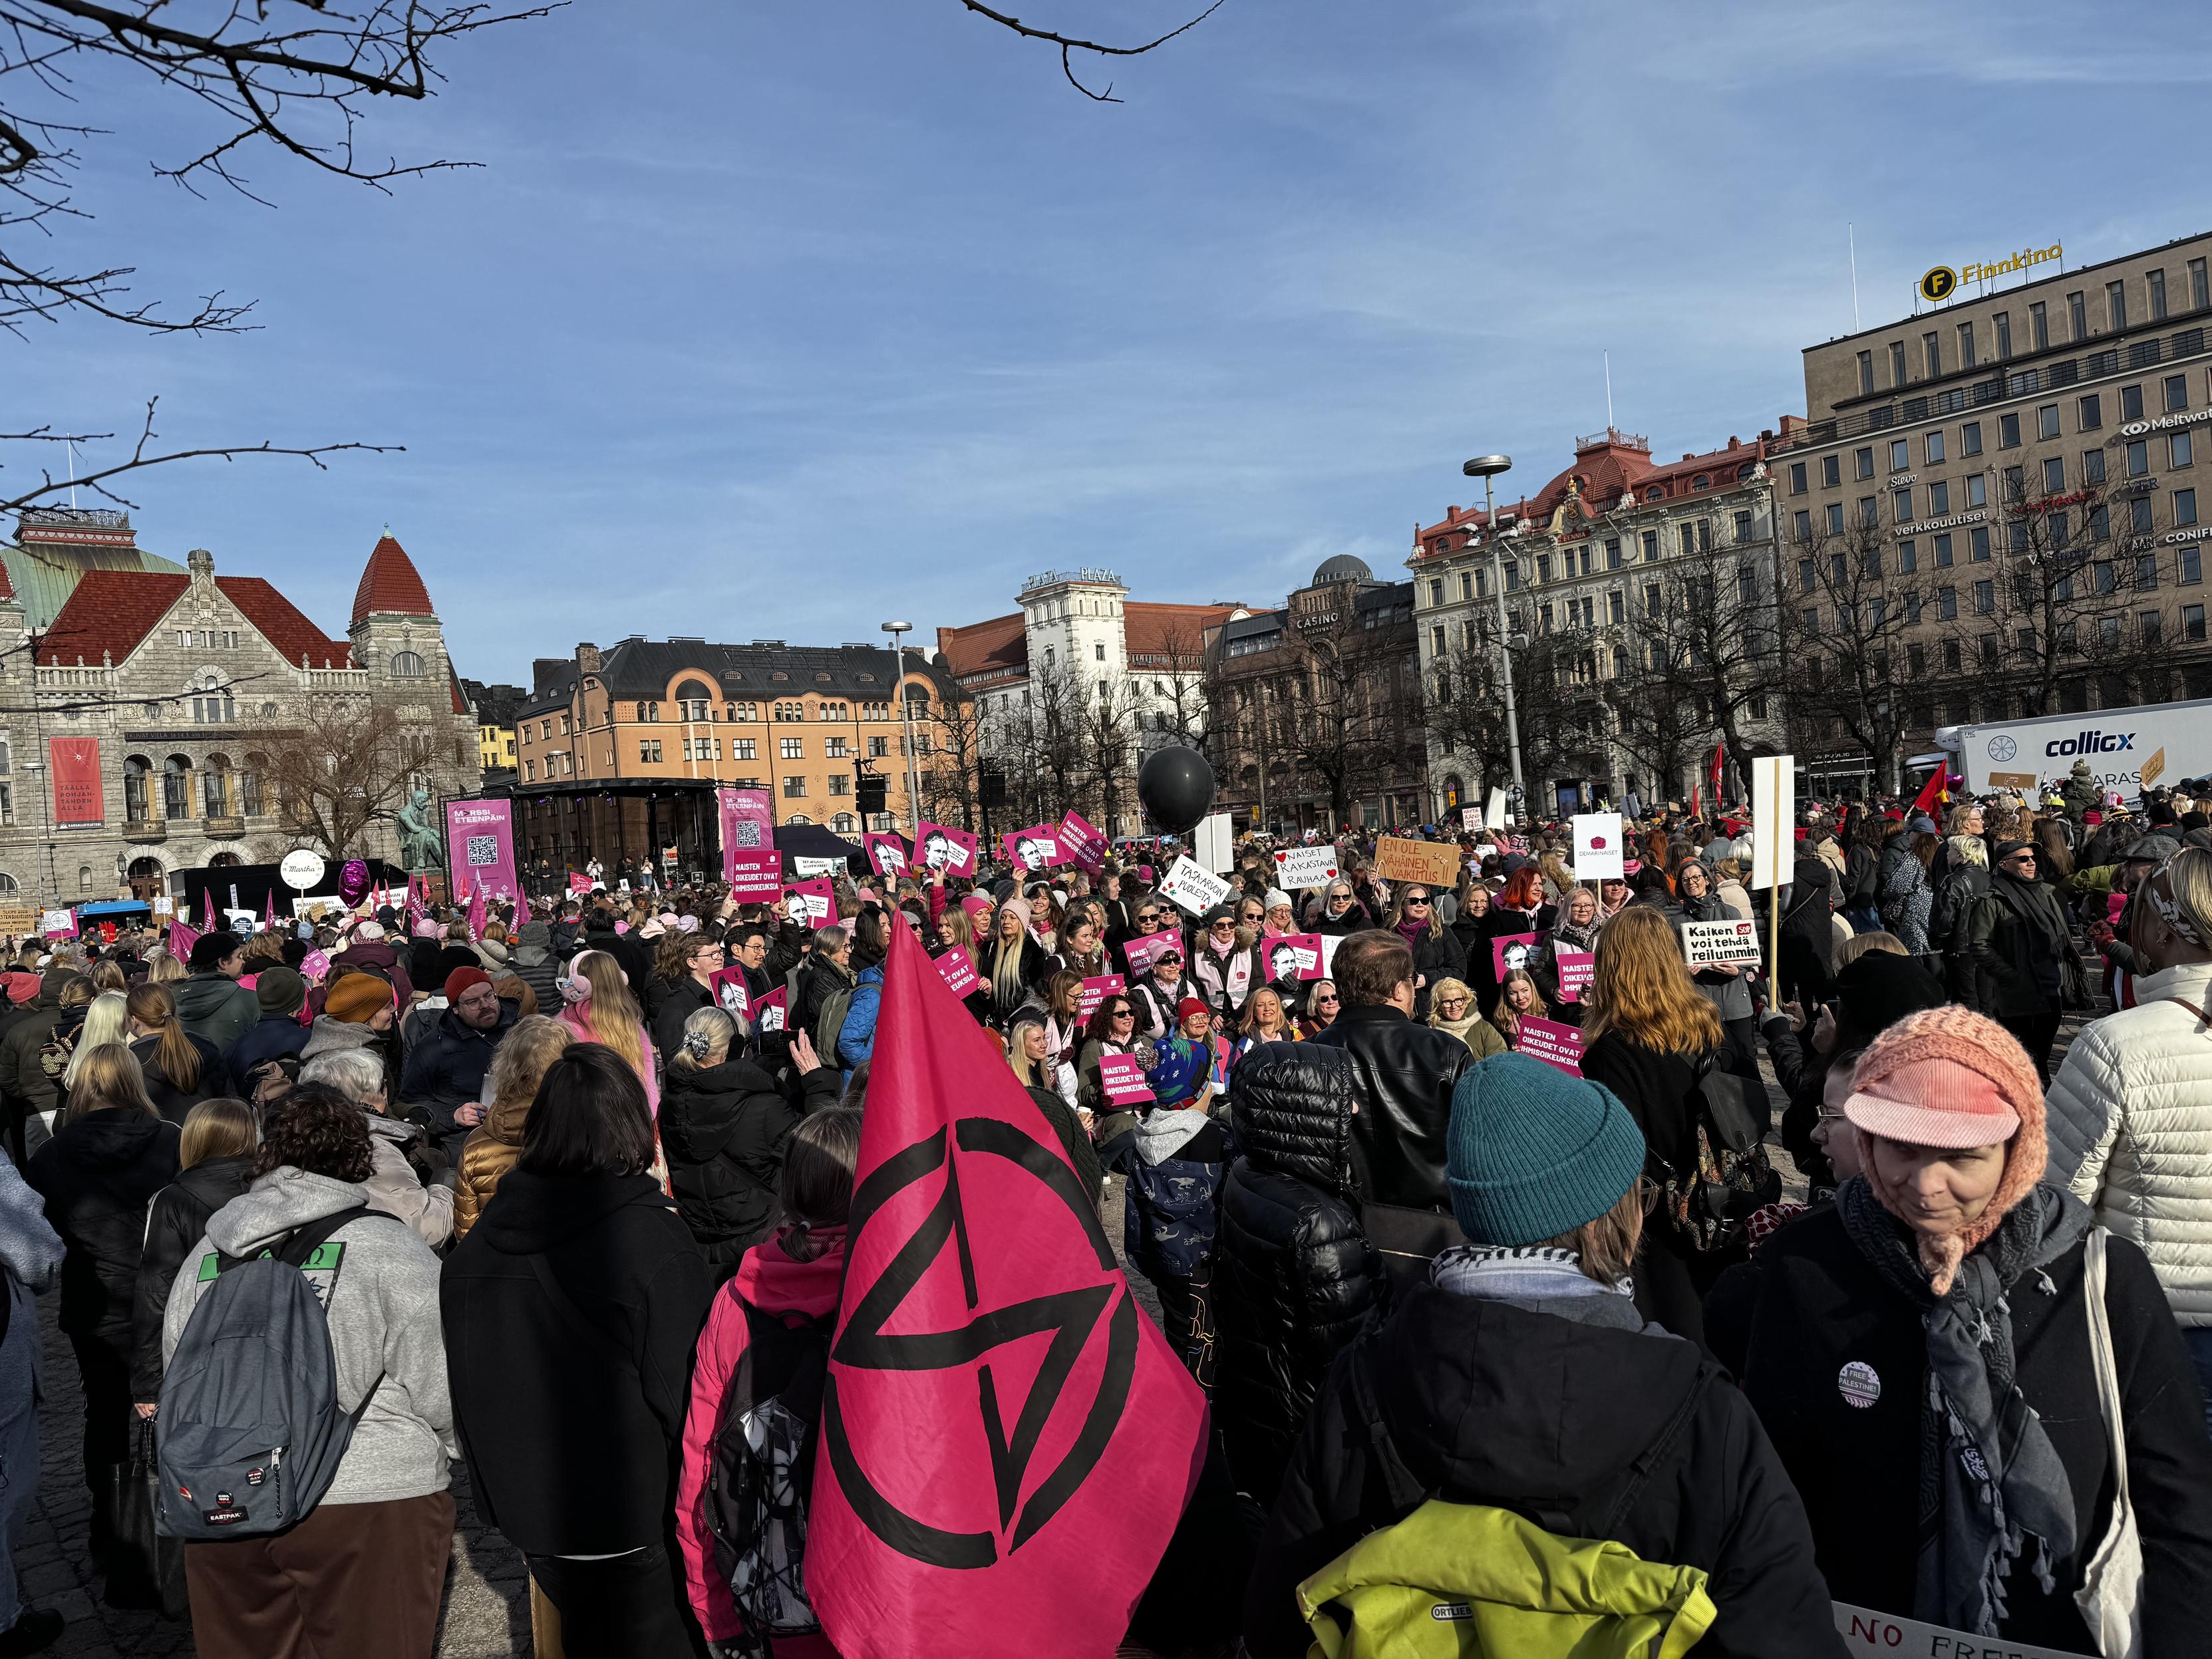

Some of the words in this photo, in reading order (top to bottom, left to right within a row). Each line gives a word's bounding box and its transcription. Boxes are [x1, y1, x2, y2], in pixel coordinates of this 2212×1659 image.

[1963, 244, 2062, 285] Finnkino
[1890, 473, 1918, 488] Sievo
[1895, 510, 1988, 536] verkkouutiset
[1028, 569, 1059, 589] PLAZA
[1080, 567, 1116, 582] PLAZA
[1297, 612, 1339, 629] CASINO
[2092, 771, 2142, 786] ARAS
[455, 814, 505, 824] ETEENPÄIN
[1066, 820, 1088, 841] NAISTEN
[1062, 827, 1086, 849] OIKEUDET
[1085, 845, 1100, 859] OVAT
[1384, 839, 1398, 852] EN
[1400, 841, 1422, 855] OLE
[1287, 848, 1321, 861] NAISET
[735, 863, 760, 871] NAISTEN
[1280, 857, 1337, 873] RAKASTAVAT
[1384, 854, 1430, 871] VÄHÄINEN
[735, 873, 763, 882] OIKEUDET
[763, 872, 778, 881] OVAT
[1181, 863, 1225, 898] TASA-ARVON
[1287, 874, 1328, 885] RAUHAA
[1391, 868, 1438, 883] VAIKUTUS
[735, 882, 779, 893] IHMISOIKEUKSIA
[1178, 879, 1211, 905] PUOLESTA
[1688, 926, 1734, 937] Kaiken
[1738, 925, 1751, 934] SDP
[1691, 938, 1712, 949] voi
[1714, 936, 1750, 948] tehdä
[1692, 946, 1759, 961] reilummin
[951, 965, 969, 980] OVAT
[1523, 1026, 1556, 1041] NAISTEN
[1522, 1036, 1558, 1052] OIKEUDET
[1559, 1046, 1581, 1058] OVAT
[1521, 1045, 1579, 1068] IHMISOIKEUKSIA
[1104, 1065, 1130, 1075] NAISTEN
[1105, 1074, 1134, 1086] OIKEUDET
[1849, 1370, 1867, 1380] FREE
[1839, 1377, 1876, 1393] PALESTINE!
[210, 1512, 241, 1521] EASTPAK
[1848, 1614, 1903, 1647] NO
